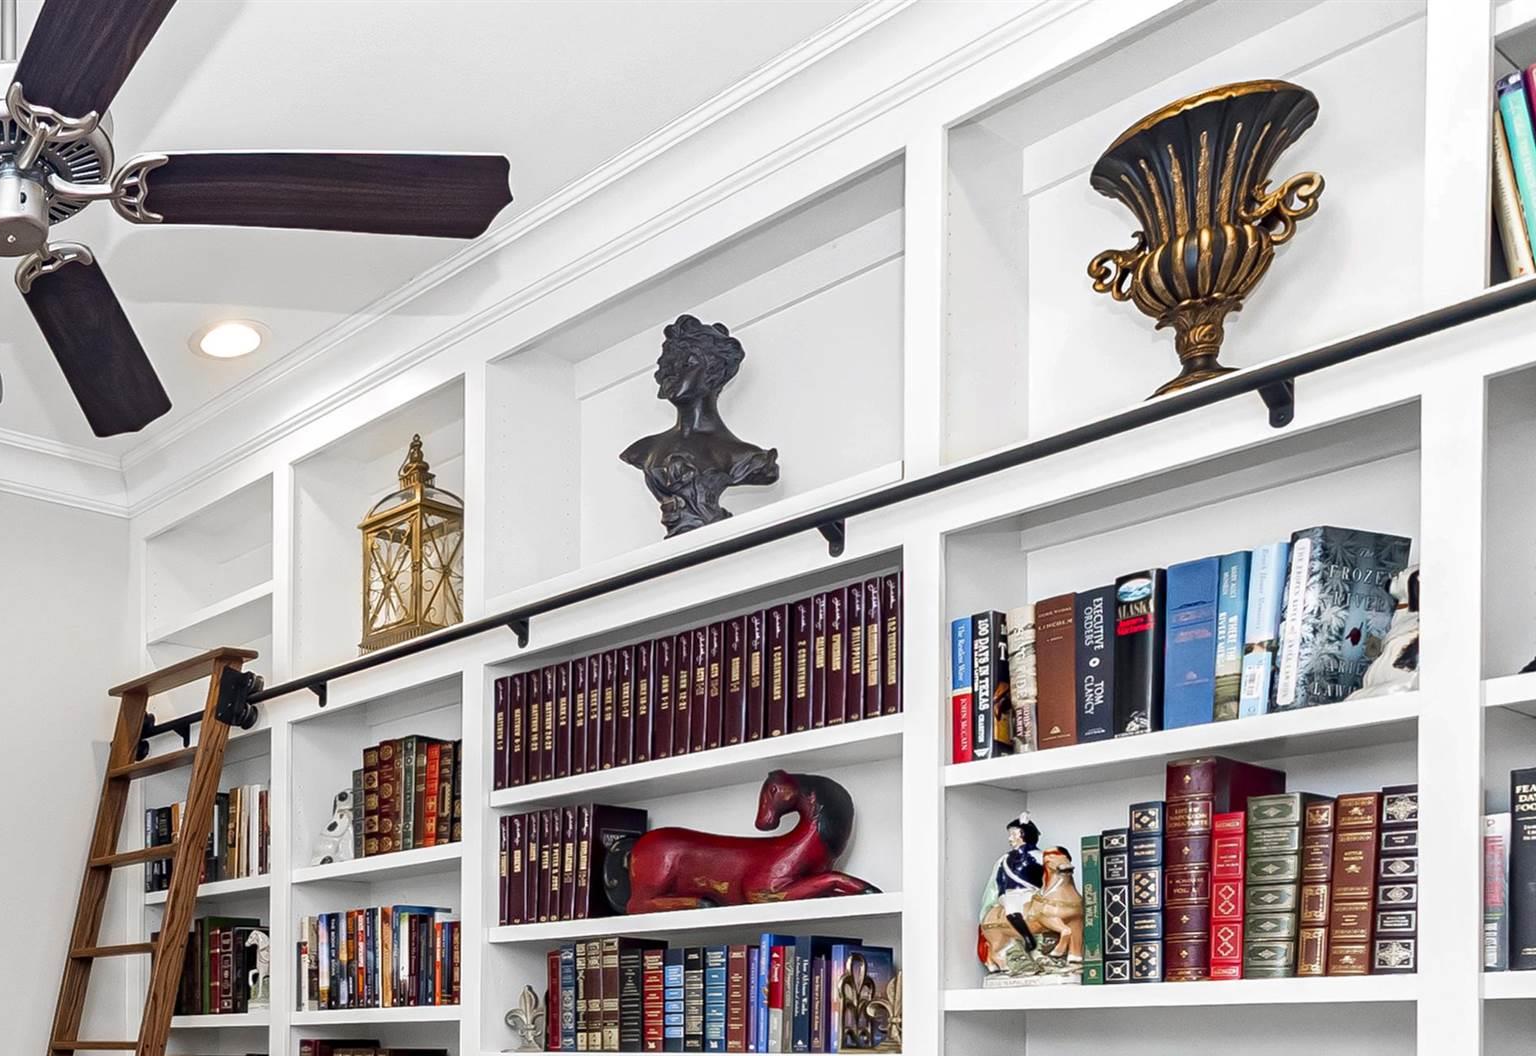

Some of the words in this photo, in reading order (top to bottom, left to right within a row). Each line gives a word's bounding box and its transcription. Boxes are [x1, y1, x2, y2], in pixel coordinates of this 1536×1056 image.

[1261, 549, 1270, 570] Beach
[1359, 548, 1374, 558] The
[1259, 573, 1268, 594] House
[1118, 599, 1154, 620] ALASKA
[1334, 590, 1386, 612] RIVER
[978, 619, 988, 635] 100
[1084, 607, 1093, 646] ORDERS
[1093, 597, 1104, 650] EXECUTIVE
[1227, 615, 1239, 643] WHERE
[852, 626, 860, 674] PHILIPPIANS
[978, 637, 990, 664] DAYS
[773, 652, 781, 700] CORINTHIANS
[797, 649, 806, 698] CORINTHIANS
[979, 665, 989, 676] IN
[679, 692, 687, 710] 12-21
[979, 677, 989, 711] TEXAS
[1085, 675, 1094, 714] CLANCY
[1094, 681, 1104, 705] TOM
[960, 698, 968, 719] JOHN
[1085, 884, 1093, 905] OSCAR
